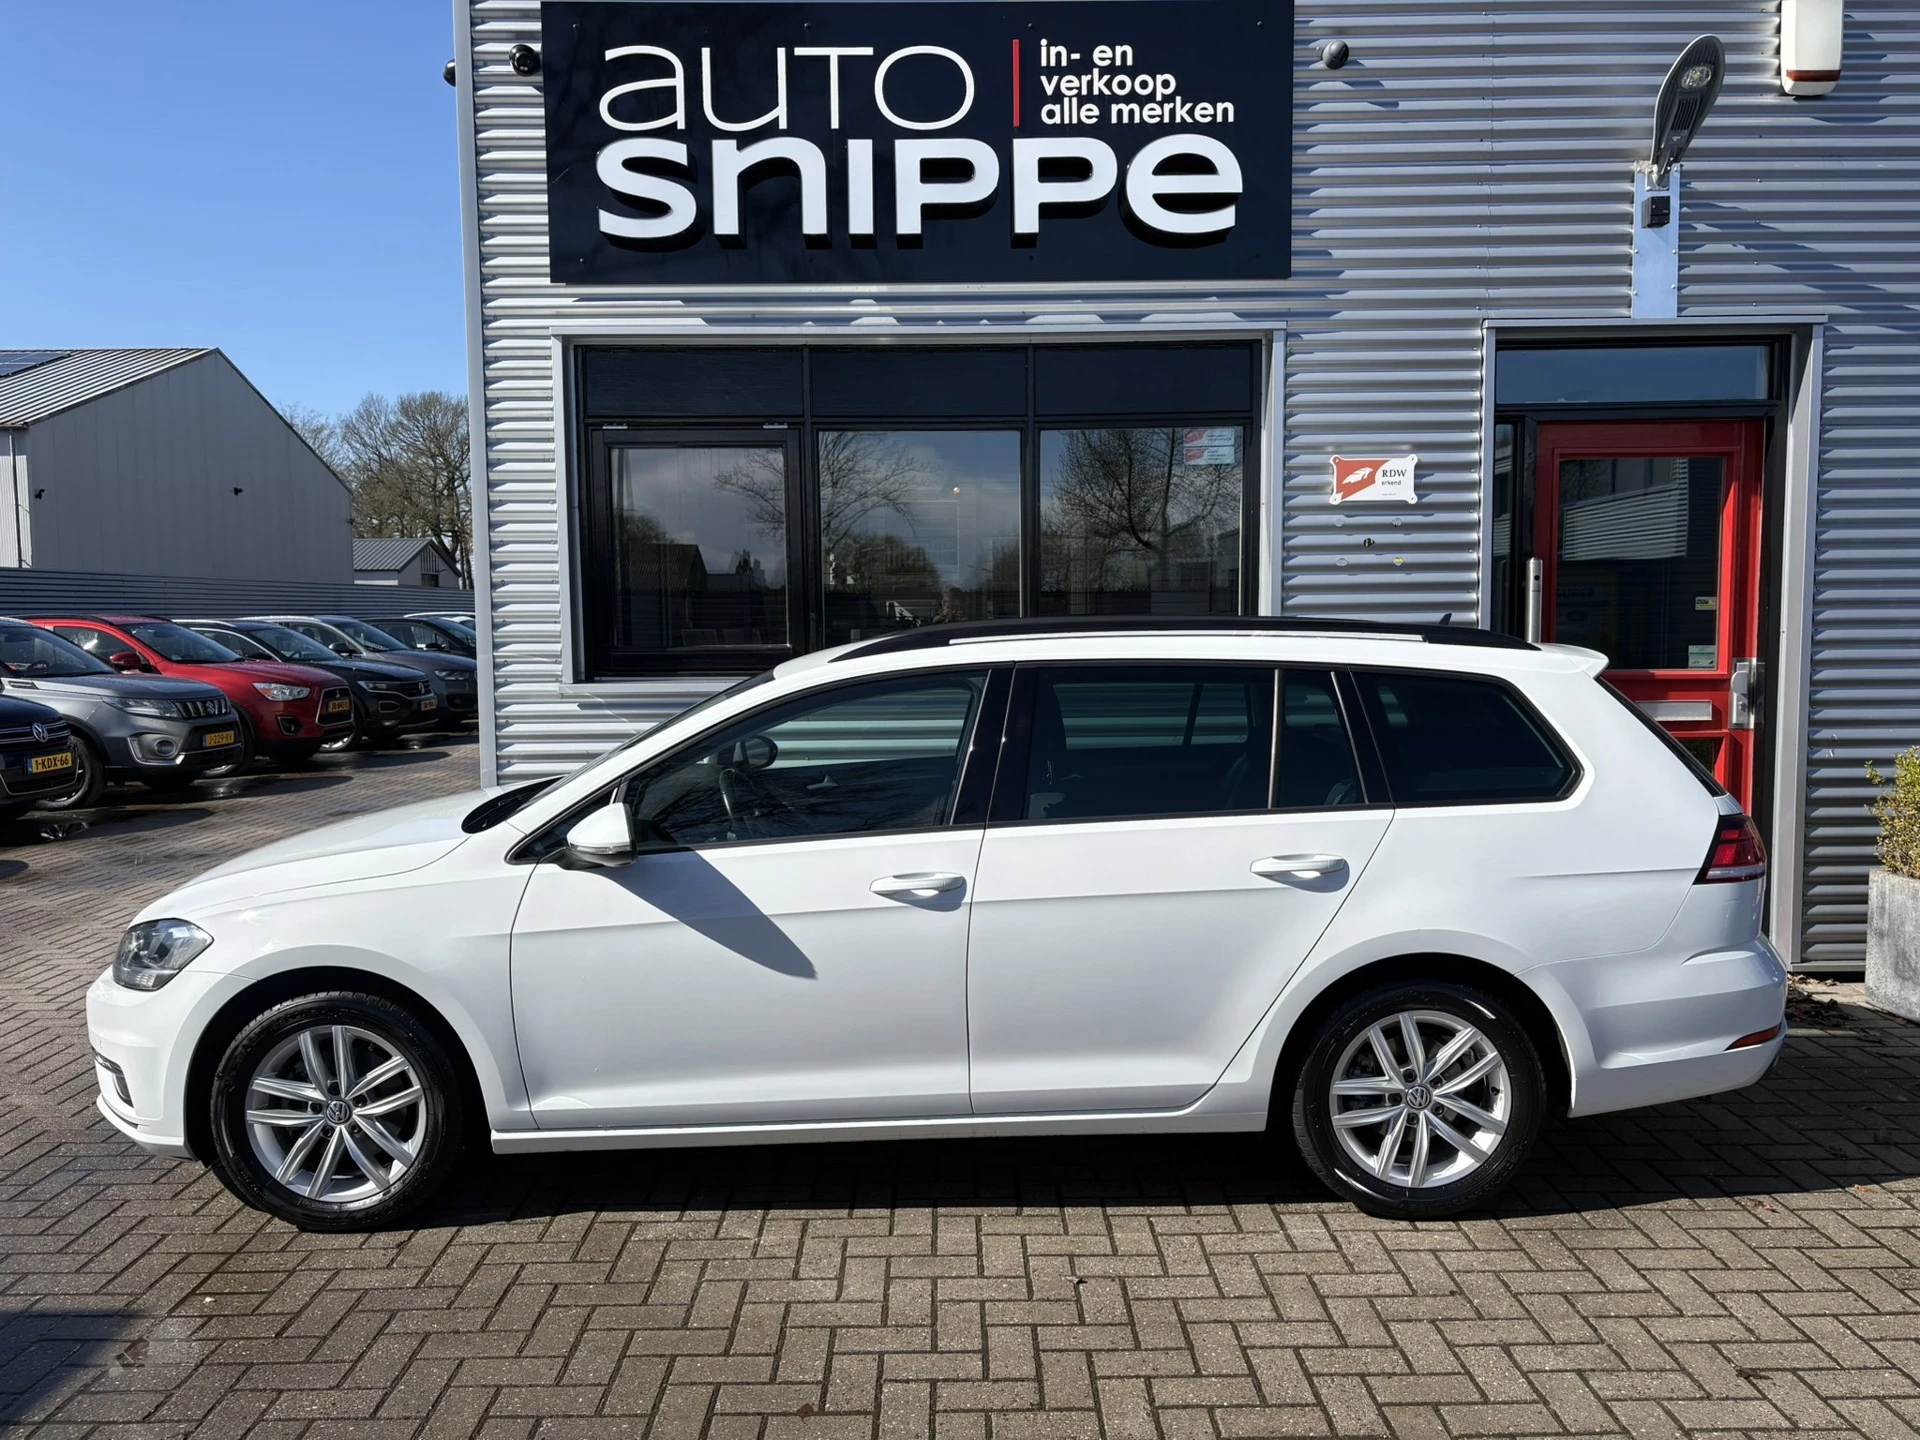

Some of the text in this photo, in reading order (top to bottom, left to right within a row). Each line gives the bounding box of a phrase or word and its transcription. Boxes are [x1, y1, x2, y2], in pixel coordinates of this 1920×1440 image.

[1040, 38, 1133, 67] in- en
[1040, 67, 1177, 102] verkoop
[1040, 95, 1234, 125] alle merken
[1382, 468, 1407, 477] RDW
[34, 754, 71, 771] 1-KDX-66
